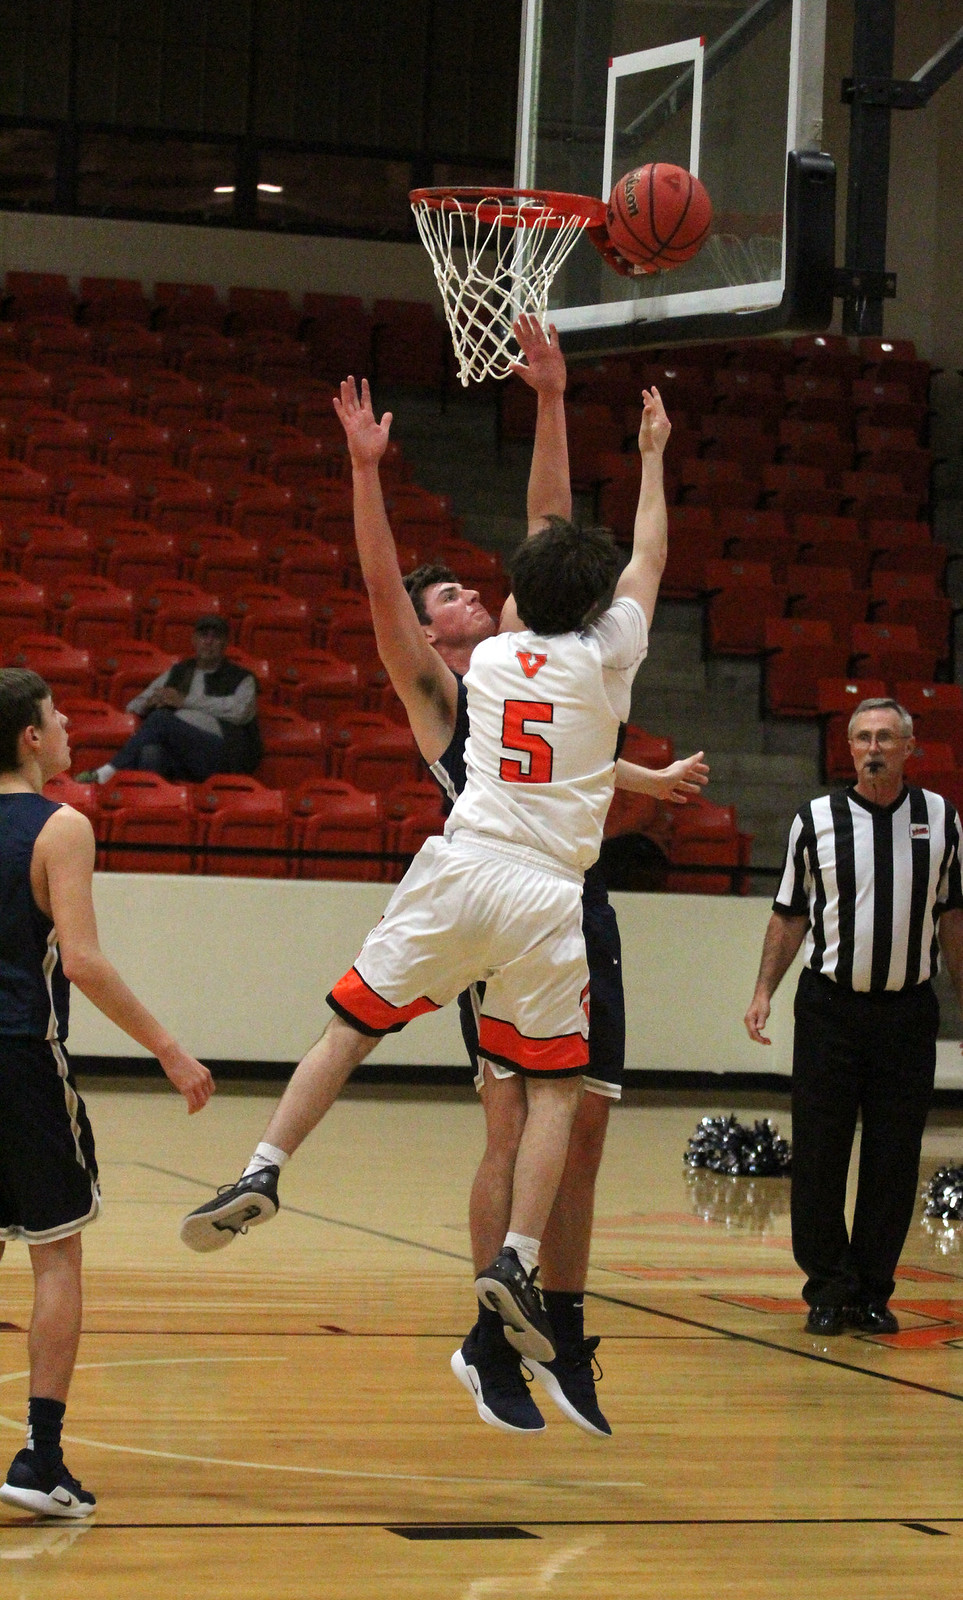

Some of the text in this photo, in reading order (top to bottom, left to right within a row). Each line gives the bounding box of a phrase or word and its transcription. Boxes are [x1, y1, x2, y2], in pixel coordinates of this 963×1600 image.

[624, 169, 641, 218] ilson
[515, 650, 548, 679] V
[499, 698, 554, 784] 5
